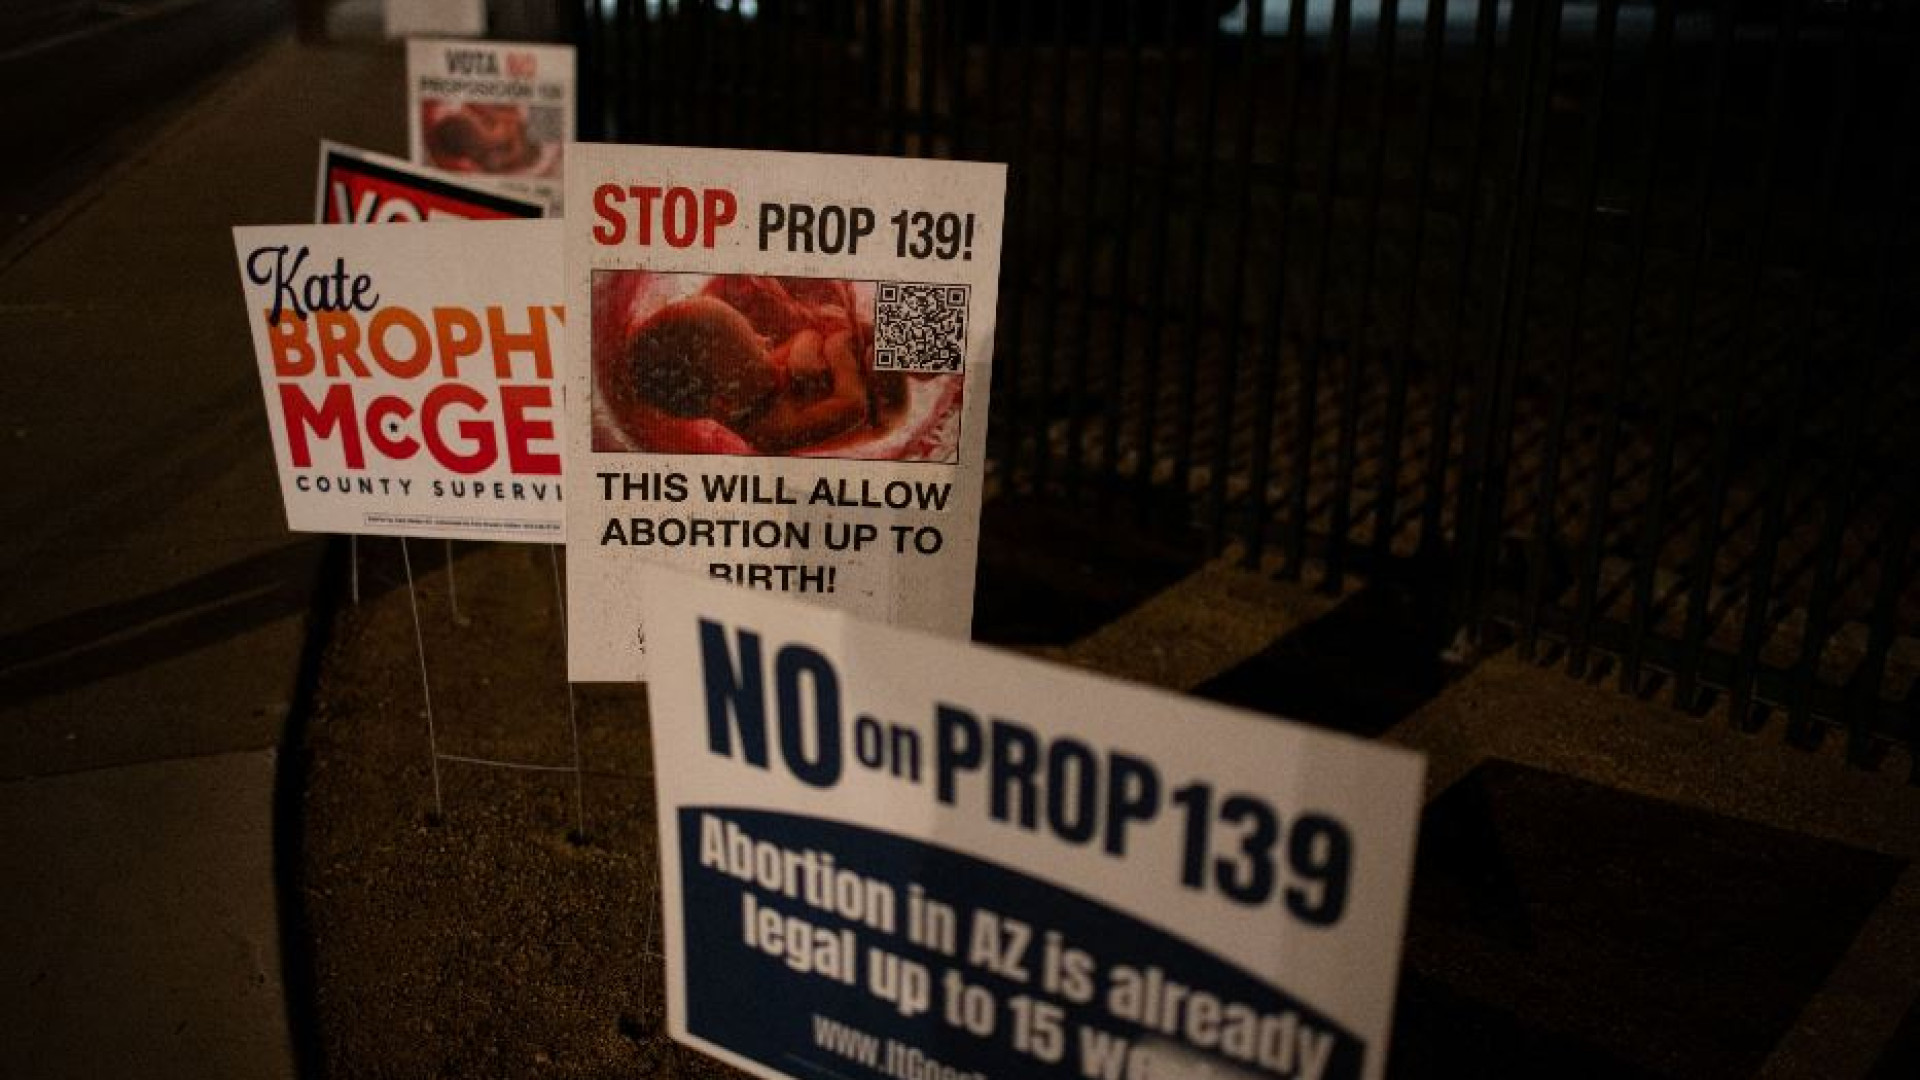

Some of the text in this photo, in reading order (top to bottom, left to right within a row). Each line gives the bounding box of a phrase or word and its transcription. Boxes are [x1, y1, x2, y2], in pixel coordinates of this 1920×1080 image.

[592, 183, 976, 261] STOP PROP 139!
[247, 245, 379, 327] Kate
[264, 305, 565, 379] BROPH
[279, 382, 562, 474] McGE
[296, 475, 412, 495] COUNTY
[597, 472, 951, 511] THIS WILL ALLOW
[600, 517, 943, 554] ABORTION UP TO
[709, 563, 837, 593] BIRTH!
[699, 618, 1353, 927] NO on PROP 139
[699, 812, 897, 936] Abortion
[906, 881, 958, 958] in
[967, 907, 1034, 985] AZ
[1040, 928, 1096, 1005] is
[1105, 962, 1338, 1080] already
[742, 890, 858, 987] legal
[866, 947, 932, 1018] up
[943, 967, 998, 1038] to
[1007, 994, 1068, 1067] 15
